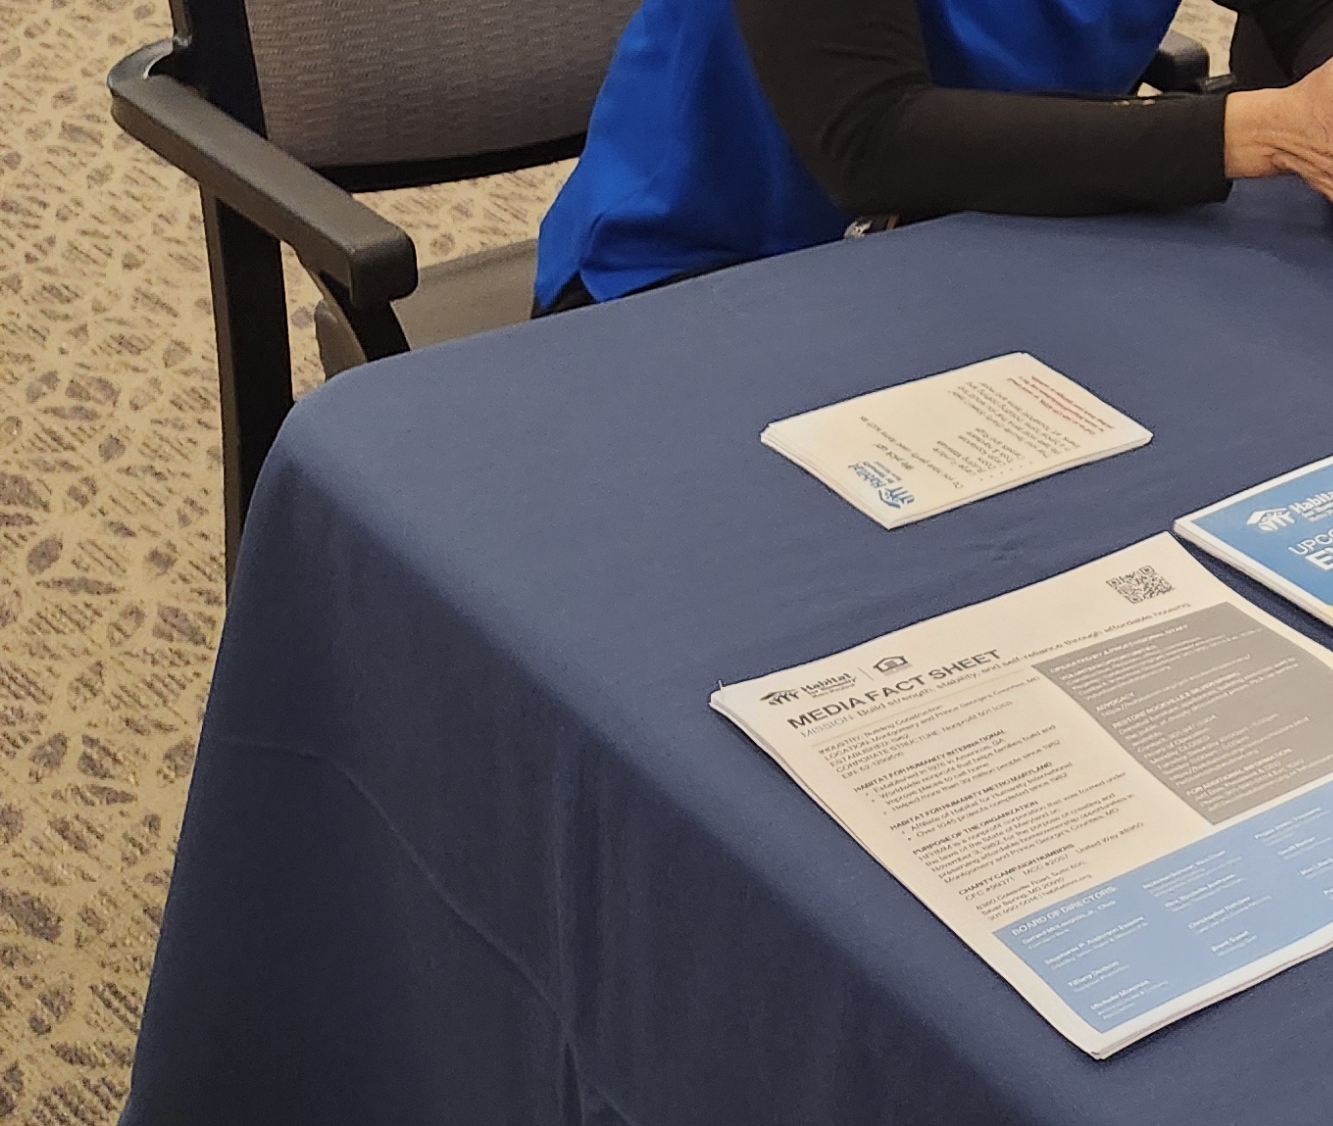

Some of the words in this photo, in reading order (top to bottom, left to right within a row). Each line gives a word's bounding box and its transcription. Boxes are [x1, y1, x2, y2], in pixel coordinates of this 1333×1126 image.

[785, 693, 867, 730] MEDIA
[863, 673, 930, 703] FACT
[926, 647, 1004, 682] SHEET
[799, 670, 852, 693] Habitat
[855, 702, 887, 717] Build
[885, 686, 934, 707] strength,
[934, 670, 980, 691] stability,
[980, 663, 1001, 674] and
[1061, 627, 1105, 647] through
[1102, 611, 1153, 634] affordable
[852, 775, 890, 792] HABITAT
[888, 768, 907, 778] FOR
[905, 753, 947, 771] HUMANITY
[944, 729, 1006, 756] INTERNATIONAL
[889, 813, 926, 830] HABITAT
[924, 806, 943, 816] FOR
[941, 790, 983, 809] HUMANITY
[981, 778, 1011, 793] METRO
[1008, 761, 1054, 782] MARYLAND
[911, 836, 951, 855] PURPOSE
[949, 831, 964, 839] OF
[962, 824, 980, 834] THE
[978, 799, 1039, 827] ORGANIZATION
[957, 876, 996, 896] CHARITY
[993, 858, 1037, 880] CAMPAIGN
[1034, 842, 1075, 862] NUMBERS
[1010, 915, 1049, 935] BOARD
[1046, 909, 1063, 919] OF
